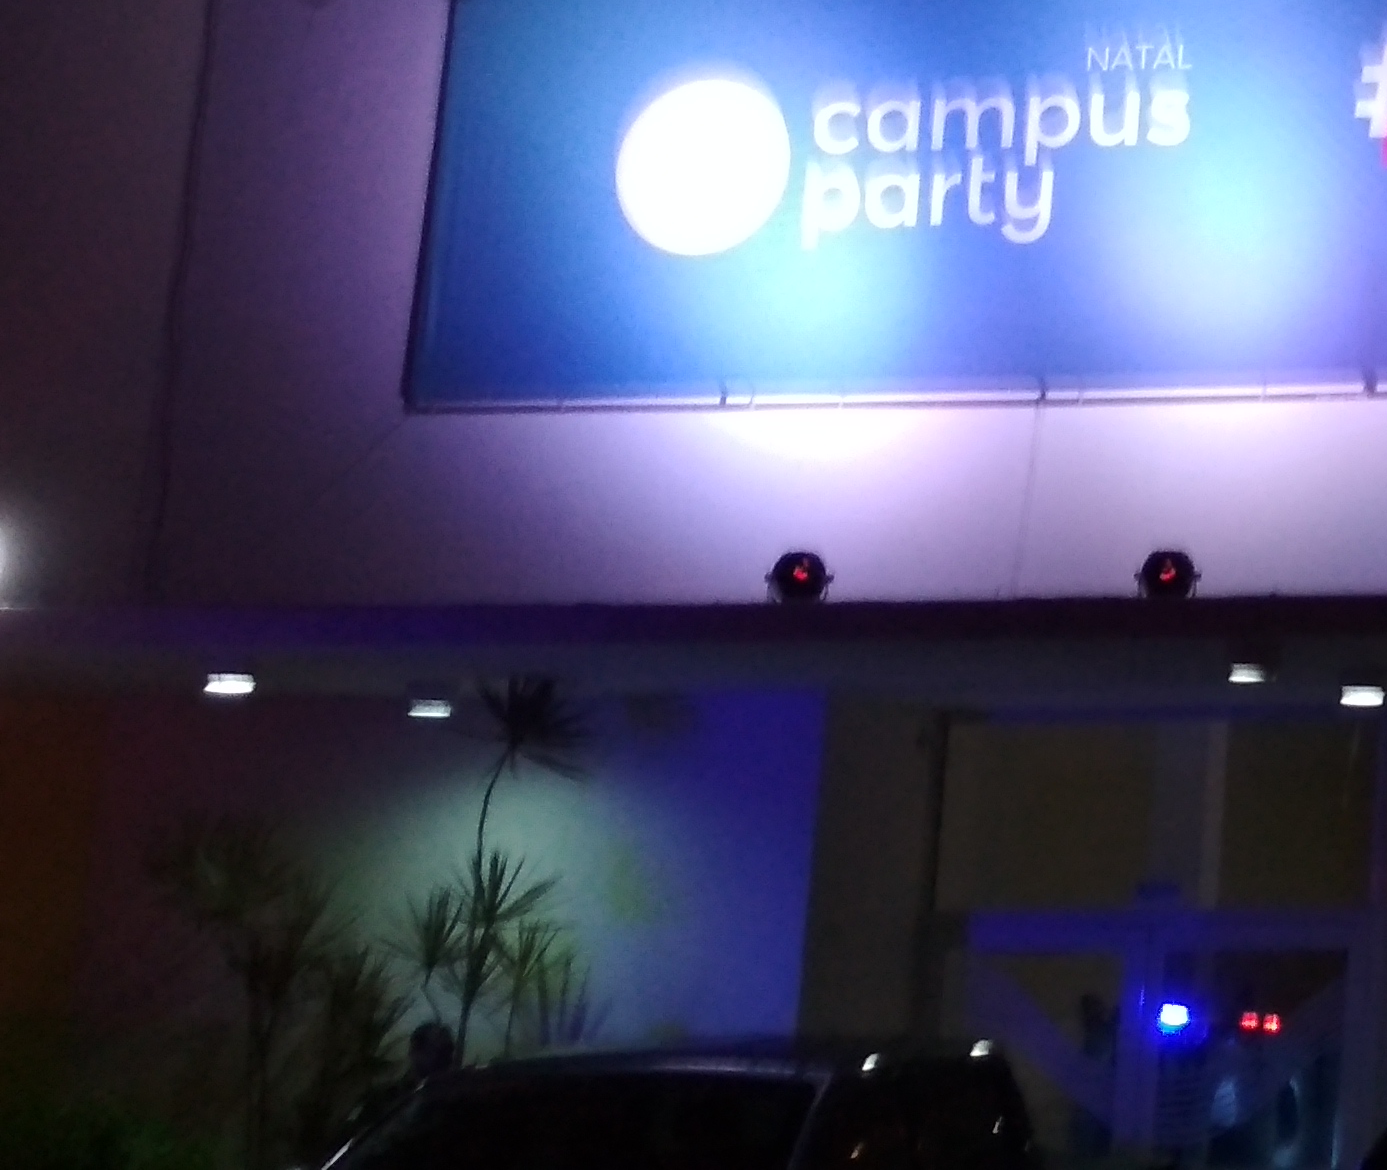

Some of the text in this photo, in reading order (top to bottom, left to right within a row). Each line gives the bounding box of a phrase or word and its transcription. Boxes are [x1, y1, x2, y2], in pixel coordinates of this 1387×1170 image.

[1086, 44, 1193, 72] NATAL
[812, 84, 1193, 166] campus
[802, 152, 1055, 249] party
